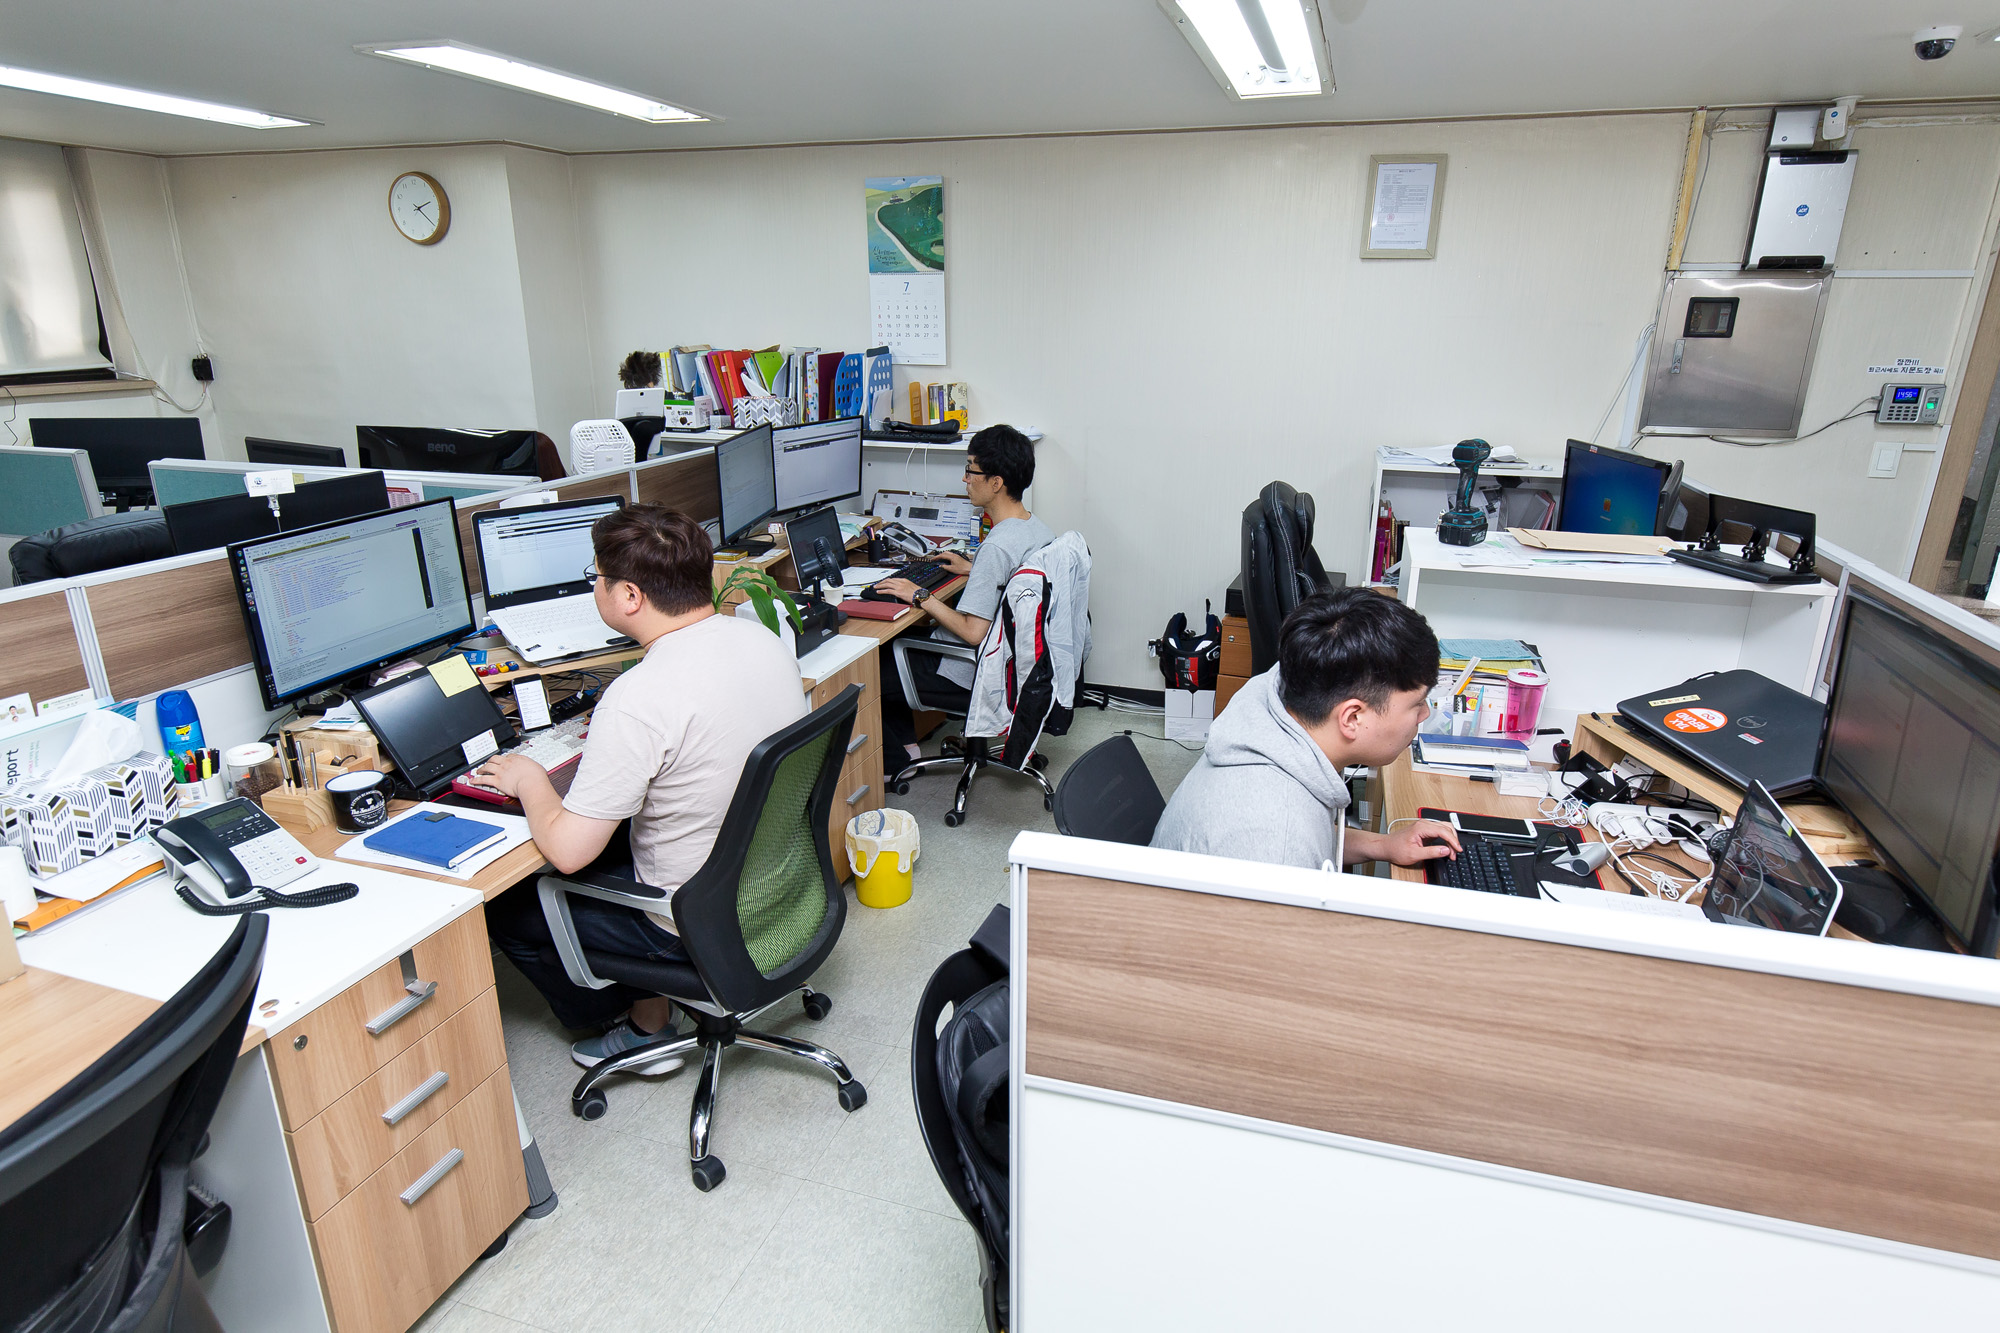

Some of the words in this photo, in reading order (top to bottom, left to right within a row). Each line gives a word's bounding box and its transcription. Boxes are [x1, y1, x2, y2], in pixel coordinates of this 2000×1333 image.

[904, 282, 910, 292] 7
[1669, 718, 1689, 730] TAX
[1675, 712, 1710, 730] REFUND
[6, 748, 21, 785] eport
